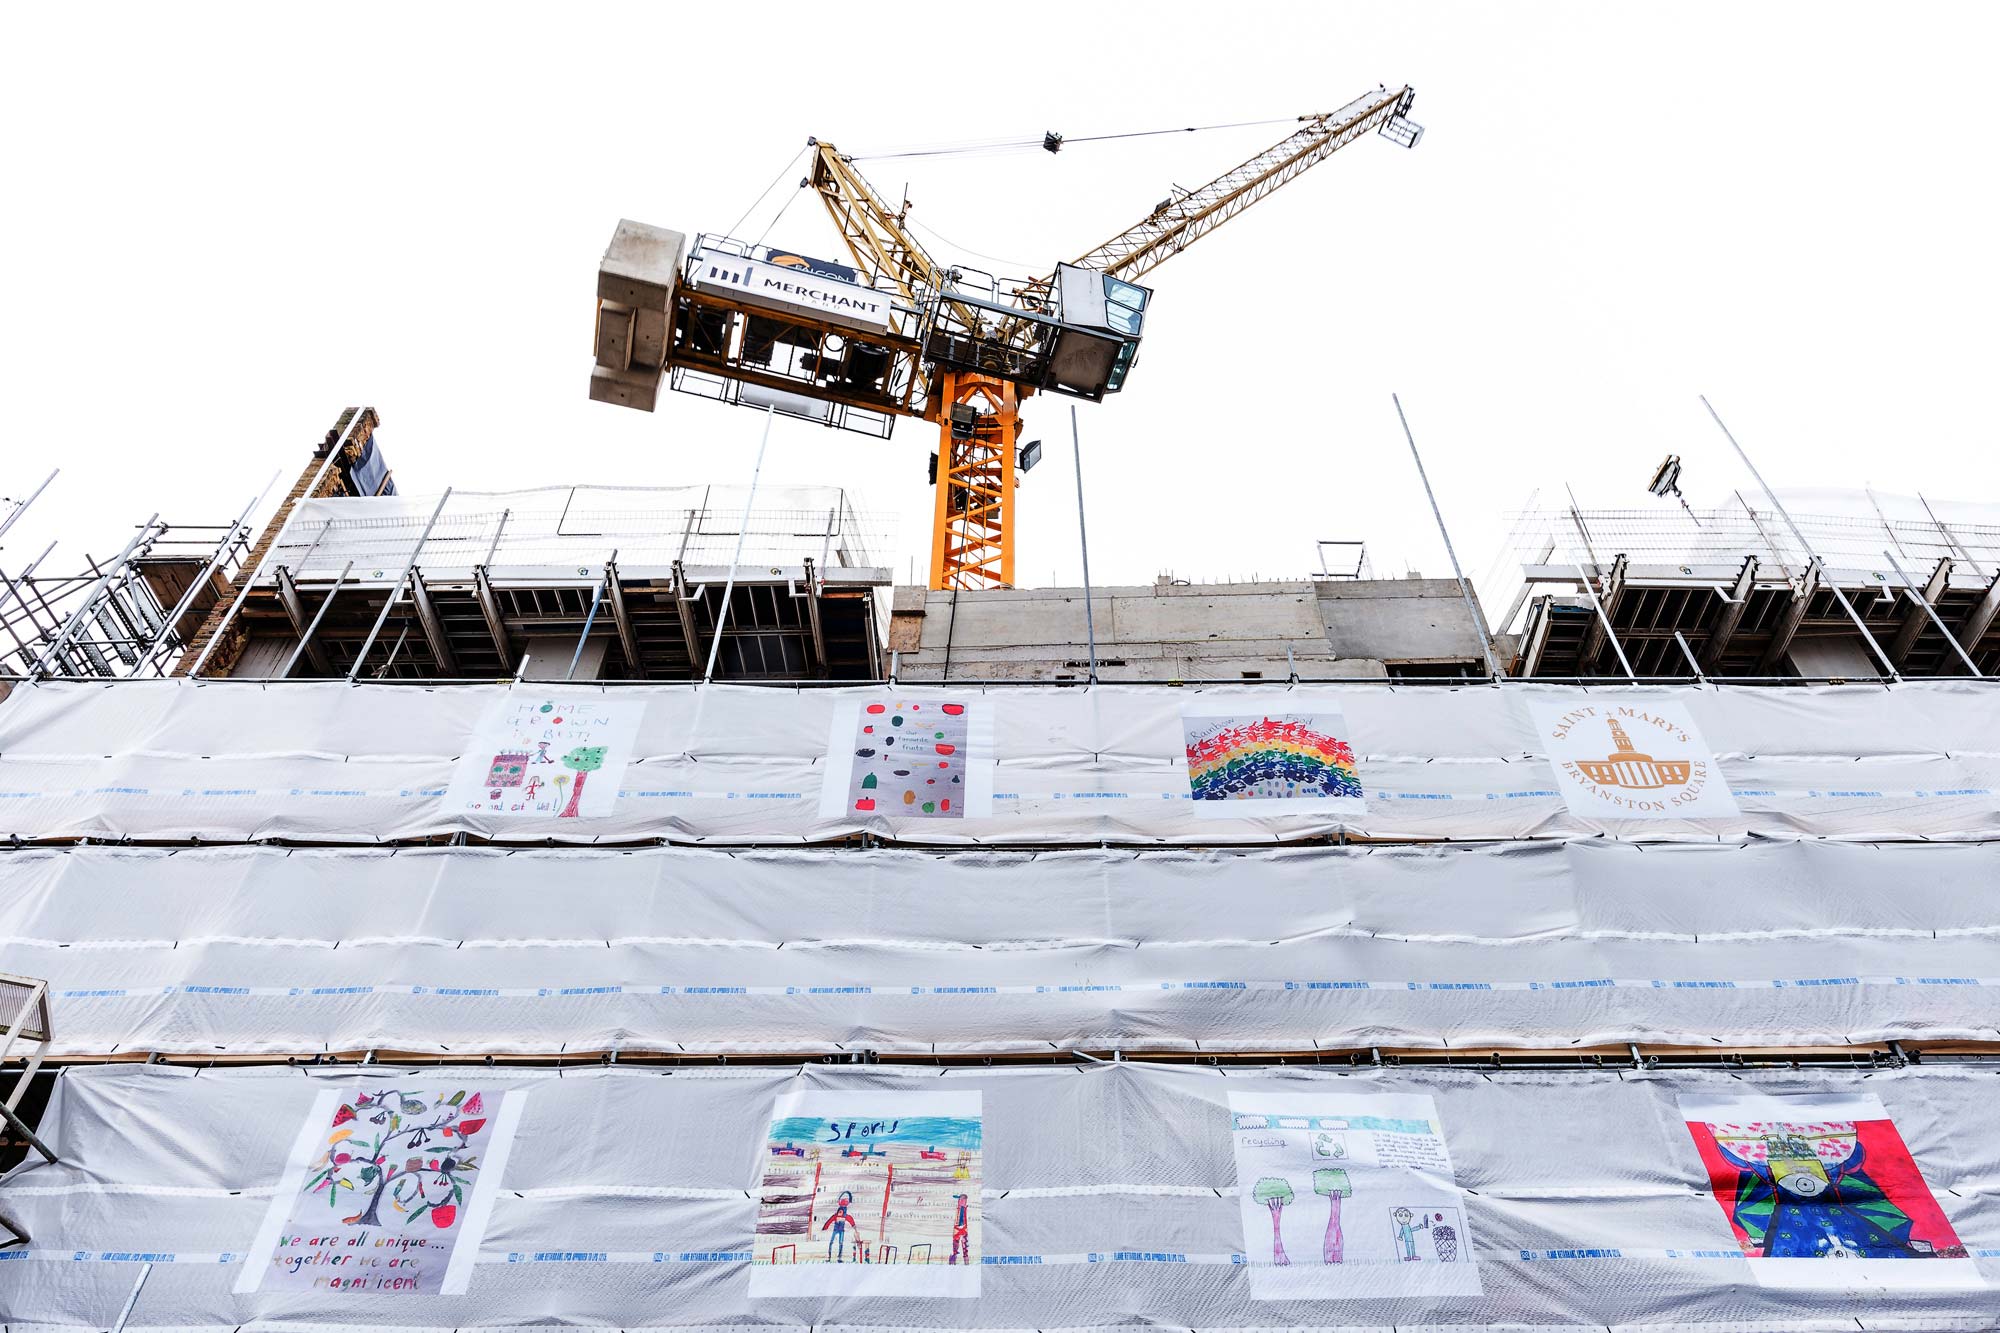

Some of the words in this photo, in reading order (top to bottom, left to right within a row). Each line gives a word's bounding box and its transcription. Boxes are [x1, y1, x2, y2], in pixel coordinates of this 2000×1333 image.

[763, 278, 880, 313] MERCHANT
[1189, 717, 1235, 740] Rainbow
[1284, 713, 1314, 726] Food
[1551, 706, 1597, 740] SAINT
[1617, 706, 1693, 743] MARY'S
[1561, 760, 1666, 812] BRYANSTON
[1671, 760, 1708, 806] SQUARE
[309, 1236, 339, 1247] are
[348, 1231, 369, 1247] all
[273, 1250, 352, 1274] together
[388, 1256, 420, 1269] are
[312, 1271, 423, 1292] magnificent
